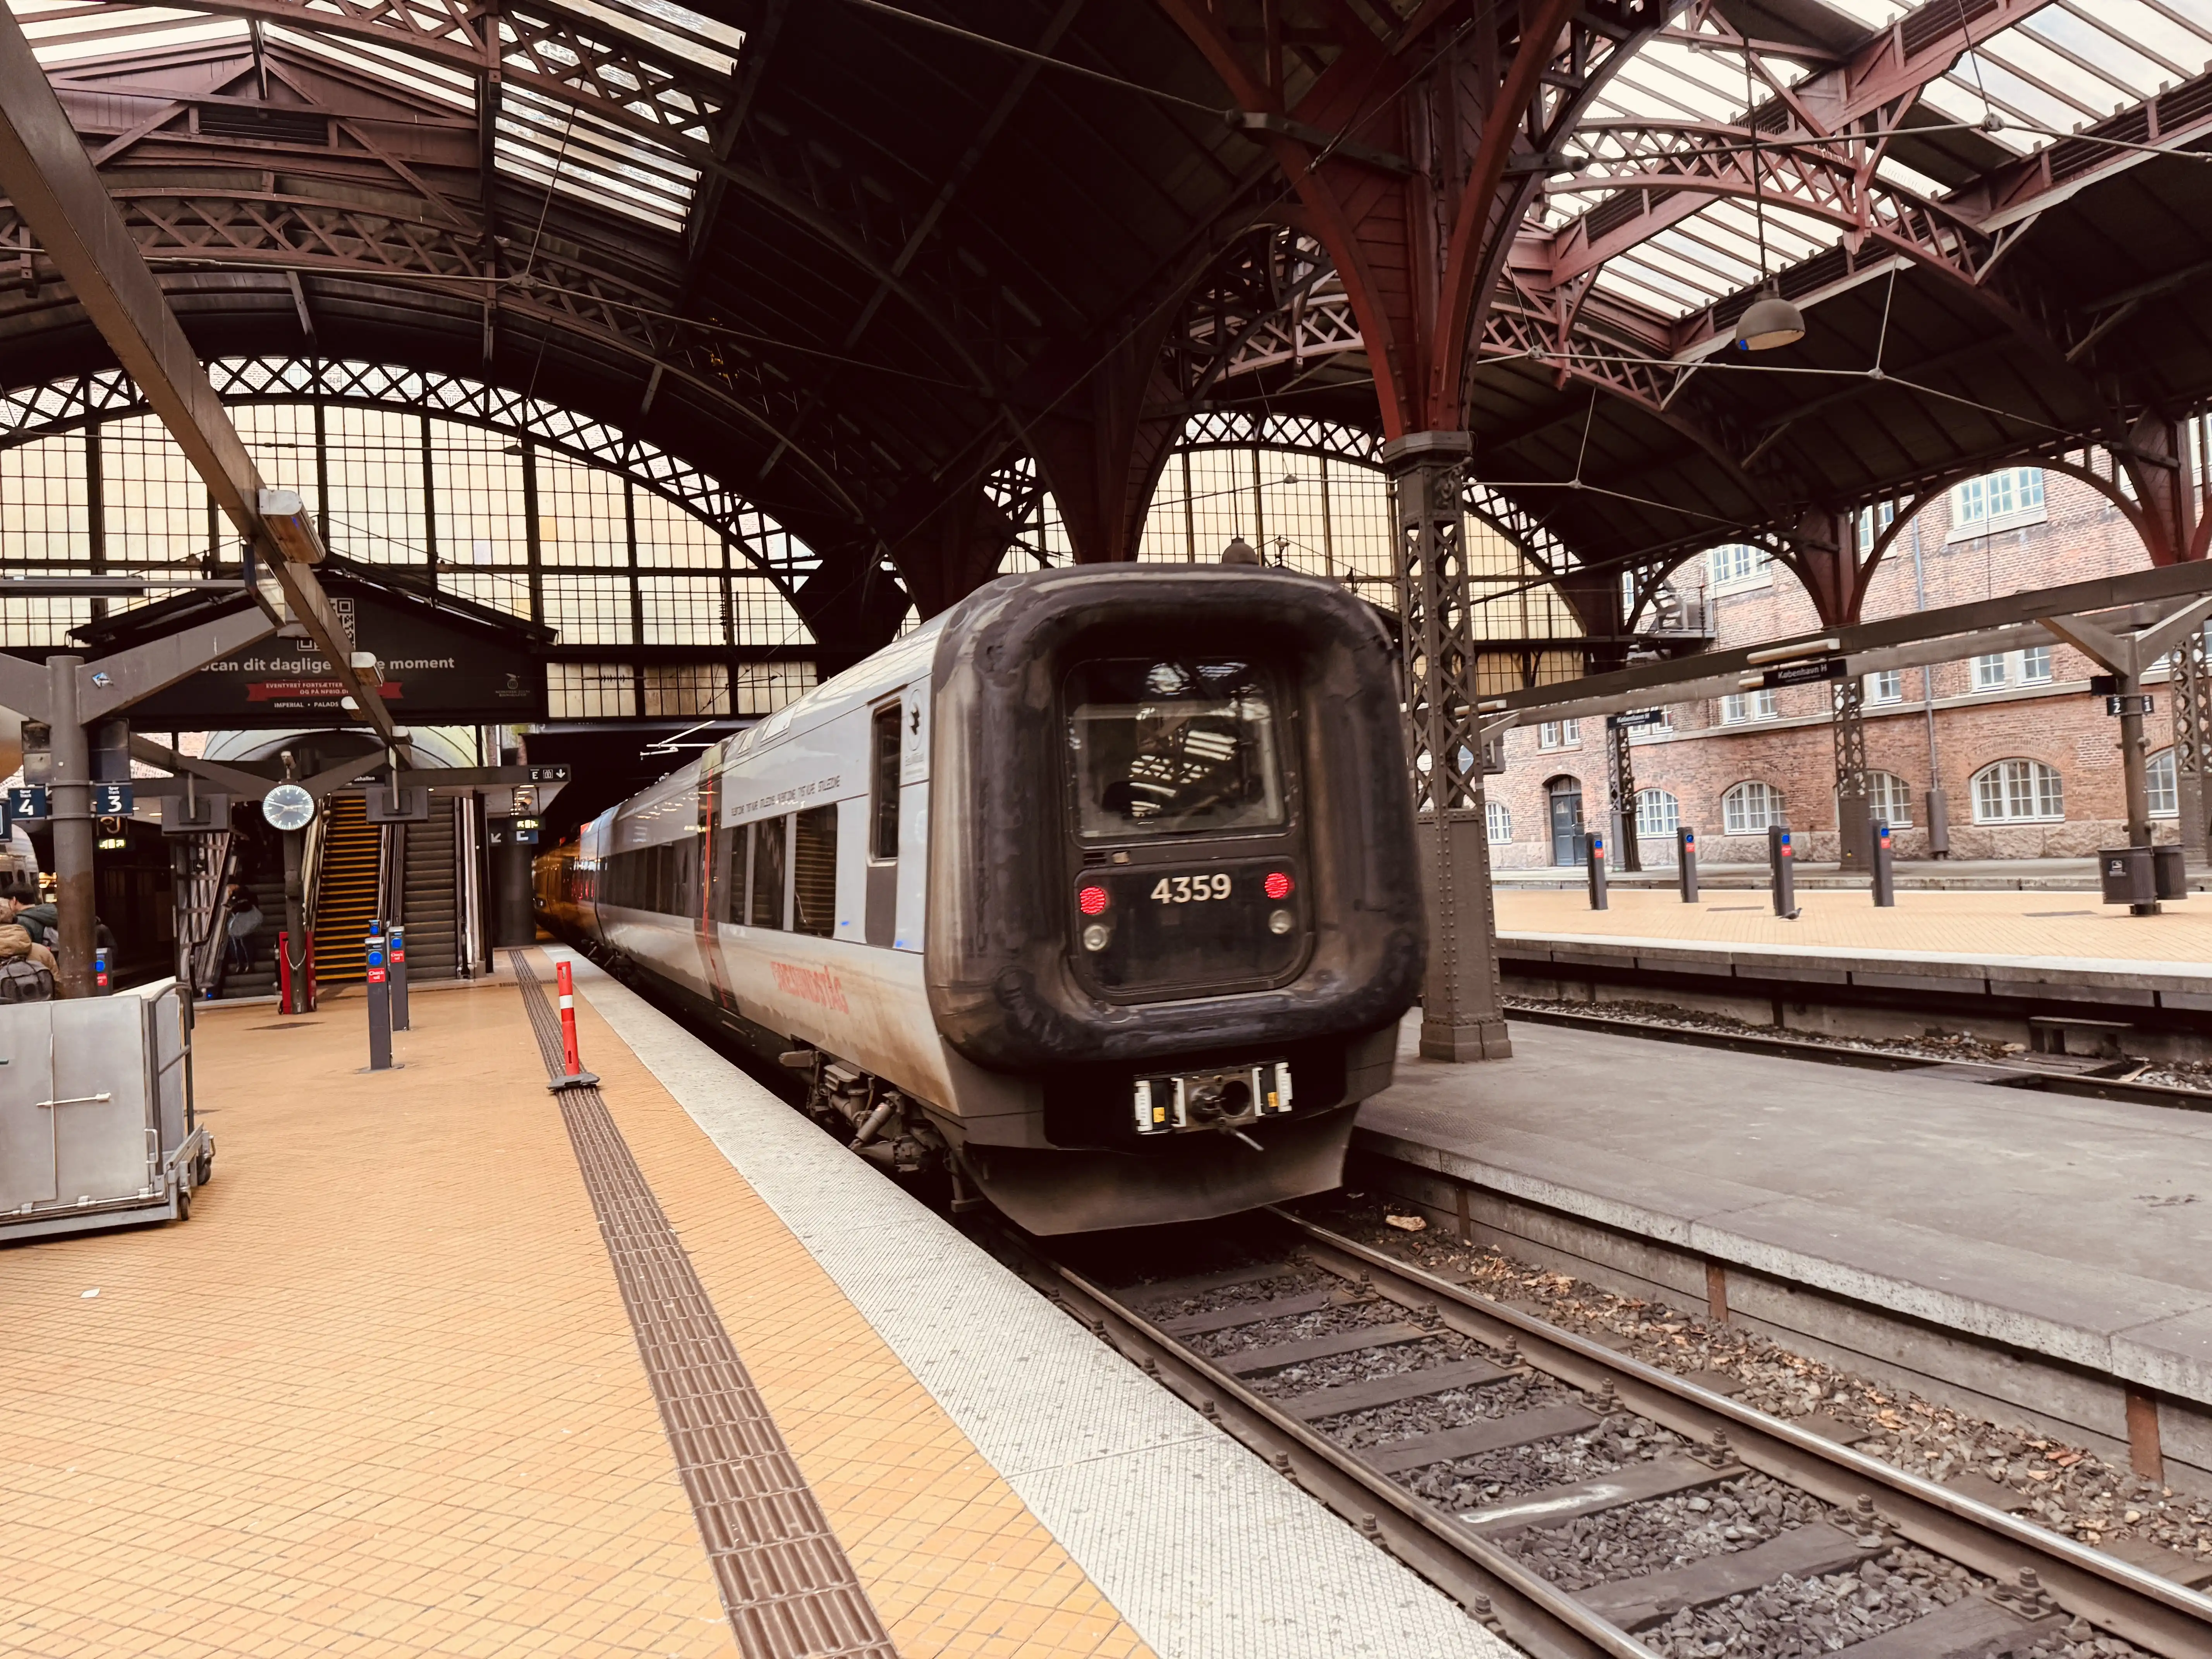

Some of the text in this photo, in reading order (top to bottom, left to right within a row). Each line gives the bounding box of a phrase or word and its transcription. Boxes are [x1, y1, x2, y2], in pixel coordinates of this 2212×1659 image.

[244, 658, 266, 671] dit
[270, 658, 331, 674] daglige
[390, 658, 455, 670] moment
[1820, 664, 1827, 672] H
[2113, 702, 2121, 713] 2
[2145, 701, 2152, 711] 1
[19, 799, 34, 816] 4
[108, 795, 122, 812] 3
[1151, 873, 1232, 904] 4359
